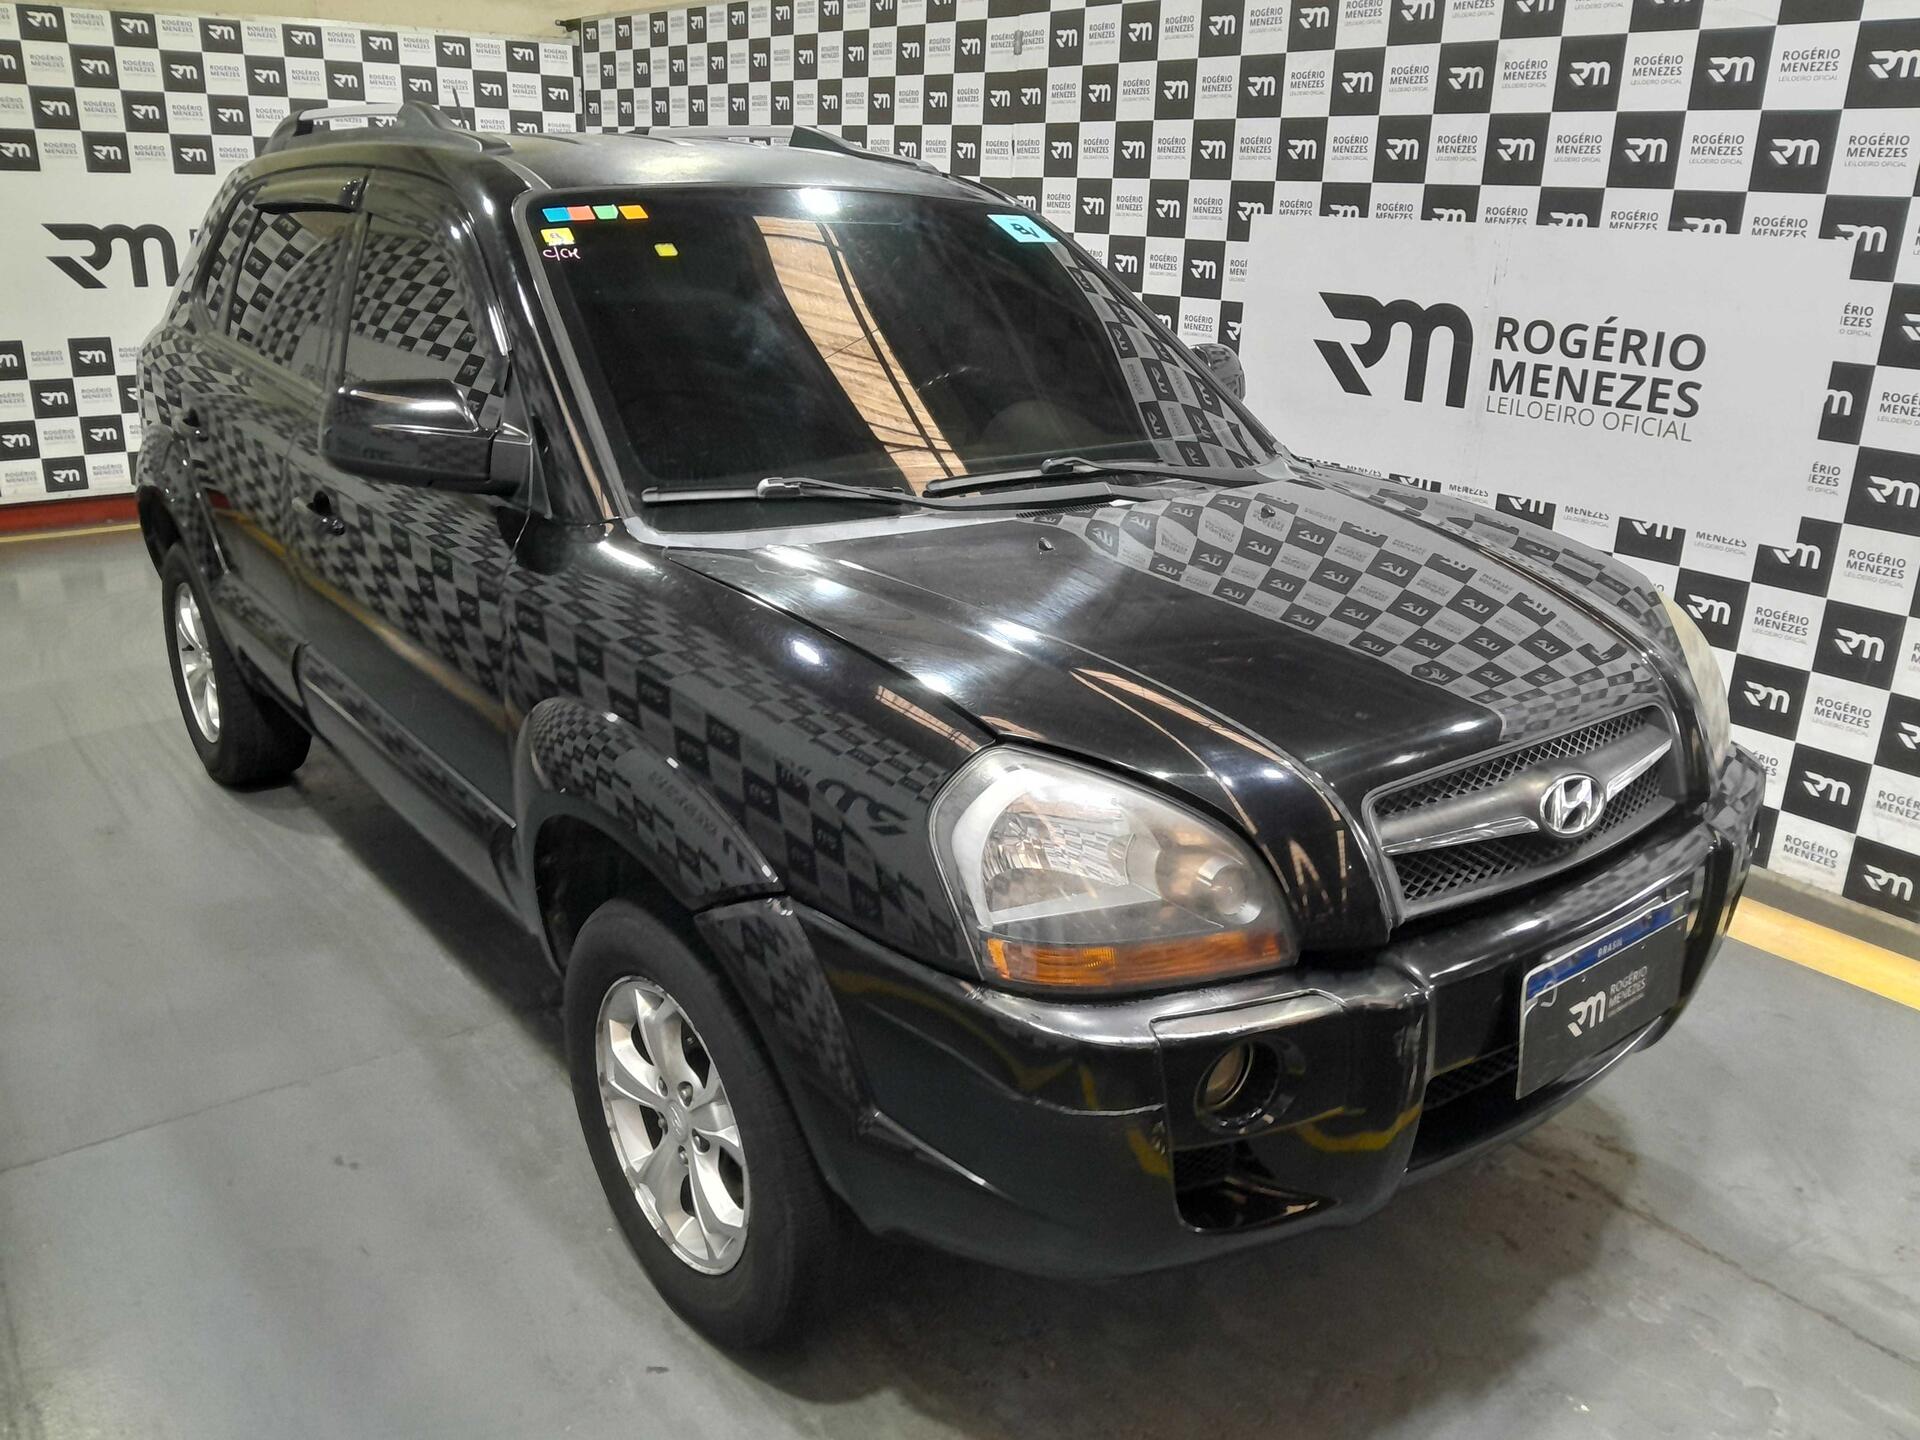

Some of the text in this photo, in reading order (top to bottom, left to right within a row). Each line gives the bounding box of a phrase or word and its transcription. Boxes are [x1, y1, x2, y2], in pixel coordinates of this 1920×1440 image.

[1250, 6, 1283, 18] ROGÉRIO
[1345, 8, 1382, 19] MENEZES
[1165, 14, 1195, 25] ROGÉRIO
[1250, 16, 1283, 27] MENEZES
[1089, 21, 1116, 32] ROGÉRIO
[1165, 24, 1194, 33] MENEZES
[1089, 31, 1115, 40] MENEZES
[1633, 53, 1684, 66] ROGÉRIO
[1782, 47, 1841, 61] ROGÉRIO
[1391, 64, 1430, 75] ROGÉRIO
[1504, 58, 1548, 71] ROGÉRIO
[1780, 61, 1839, 73] MENEZES
[1291, 69, 1325, 80] ROGÉRIO
[1503, 70, 1547, 81] MENEZES
[1632, 66, 1683, 77] MENEZES
[1123, 78, 1150, 87] ROGÉRIO
[1202, 74, 1233, 84] ROGÉRIO
[1290, 80, 1325, 89] MENEZES
[1390, 75, 1429, 85] MENEZES
[1052, 82, 1076, 91] ROGÉRIO
[1122, 87, 1150, 95] MENEZES
[1201, 84, 1232, 92] MENEZES
[1017, 138, 1040, 146] ROGÉRIO
[1084, 137, 1109, 146] ROGÉRIO
[1158, 136, 1186, 145] ROGÉRIO
[1240, 135, 1272, 145] ROGÉRIO
[1333, 134, 1369, 144] ROGÉRIO
[1437, 133, 1478, 144] ROGÉRIO
[1556, 132, 1603, 144] ROGÉRIO
[1692, 132, 1745, 144] ROGÉRIO
[1848, 132, 1910, 146] ROGÉRIO
[1332, 145, 1368, 153] MENEZES
[1436, 145, 1477, 154] MENEZES
[1555, 145, 1601, 154] MENEZES
[1690, 146, 1744, 156] MENEZES
[1846, 147, 1908, 158] MENEZES
[1047, 192, 1071, 201] ROGÉRIO
[1116, 194, 1143, 203] ROGÉRIO
[1193, 196, 1223, 206] ROGÉRIO
[1116, 203, 1143, 211] MENEZES
[1280, 198, 1313, 208] ROGÉRIO
[1376, 201, 1414, 212] ROGÉRIO
[1193, 206, 1223, 214] MENEZES
[1486, 205, 1528, 216] ROGÉRIO
[1610, 209, 1659, 221] ROGÉRIO
[1753, 215, 1809, 228] ROGÉRIO
[1150, 253, 1178, 263] ROGÉRIO
[1149, 262, 1177, 271] MENEZES
[1184, 314, 1213, 324] ROGÉRIO
[1184, 322, 1213, 332] MENEZES
[1494, 316, 1707, 372] ROGÉRIO
[1489, 358, 1703, 419] MENEZES
[1486, 395, 1693, 442] LEILOEIRO OFICIAL
[1848, 549, 1907, 568] ROGÉRIO
[1845, 559, 1905, 579] MENEZES
[1755, 606, 1809, 626] ROGÉRIO
[1754, 616, 1808, 636] MENEZES
[1816, 696, 1872, 718] ROGÉRIO
[1814, 706, 1870, 728] MENEZES
[1785, 834, 1839, 858] ROGÉRIO
[1783, 843, 1837, 868] MENEZES
